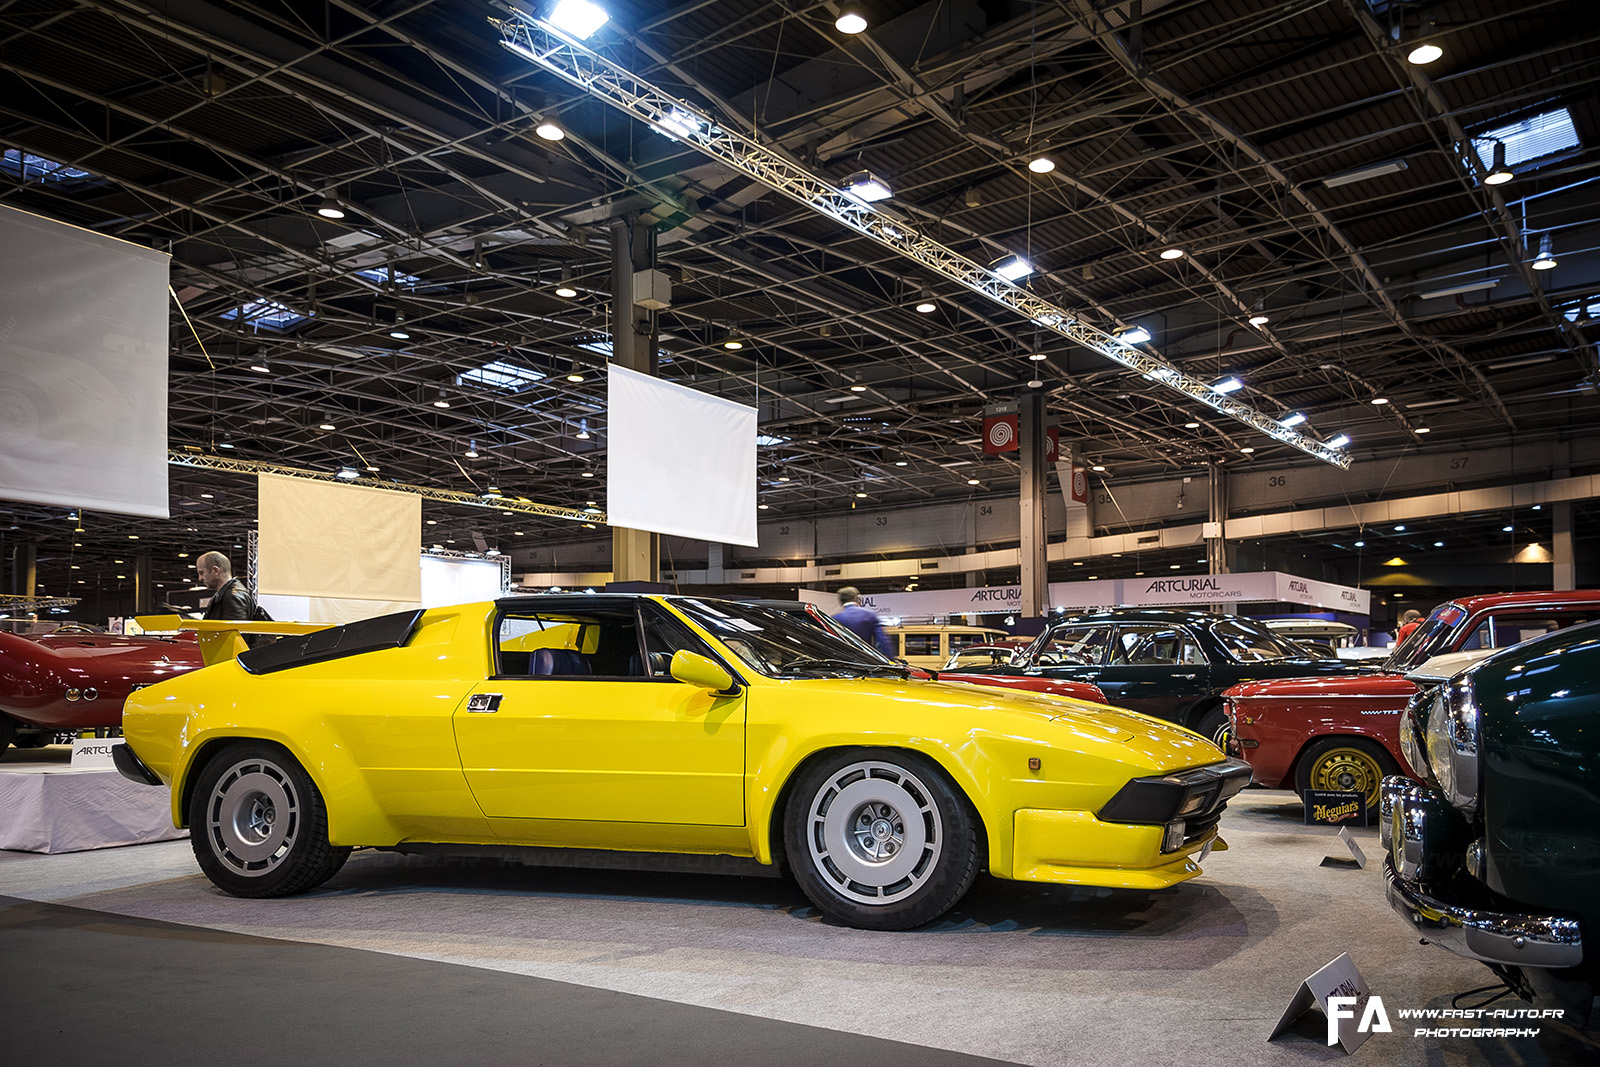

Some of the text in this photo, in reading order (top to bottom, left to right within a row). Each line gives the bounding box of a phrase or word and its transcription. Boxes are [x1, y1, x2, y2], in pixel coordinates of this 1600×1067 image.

[1450, 456, 1469, 470] 37
[1269, 475, 1286, 487] 36
[1098, 494, 1112, 505] 35
[980, 505, 992, 516] 34
[875, 516, 888, 526] 33
[779, 526, 790, 535] 32
[1145, 578, 1221, 594] ARTCURIAL
[1189, 590, 1242, 599] MOTORCARS
[75, 746, 113, 755] ARTCU
[1313, 801, 1359, 823] Meguiar's
